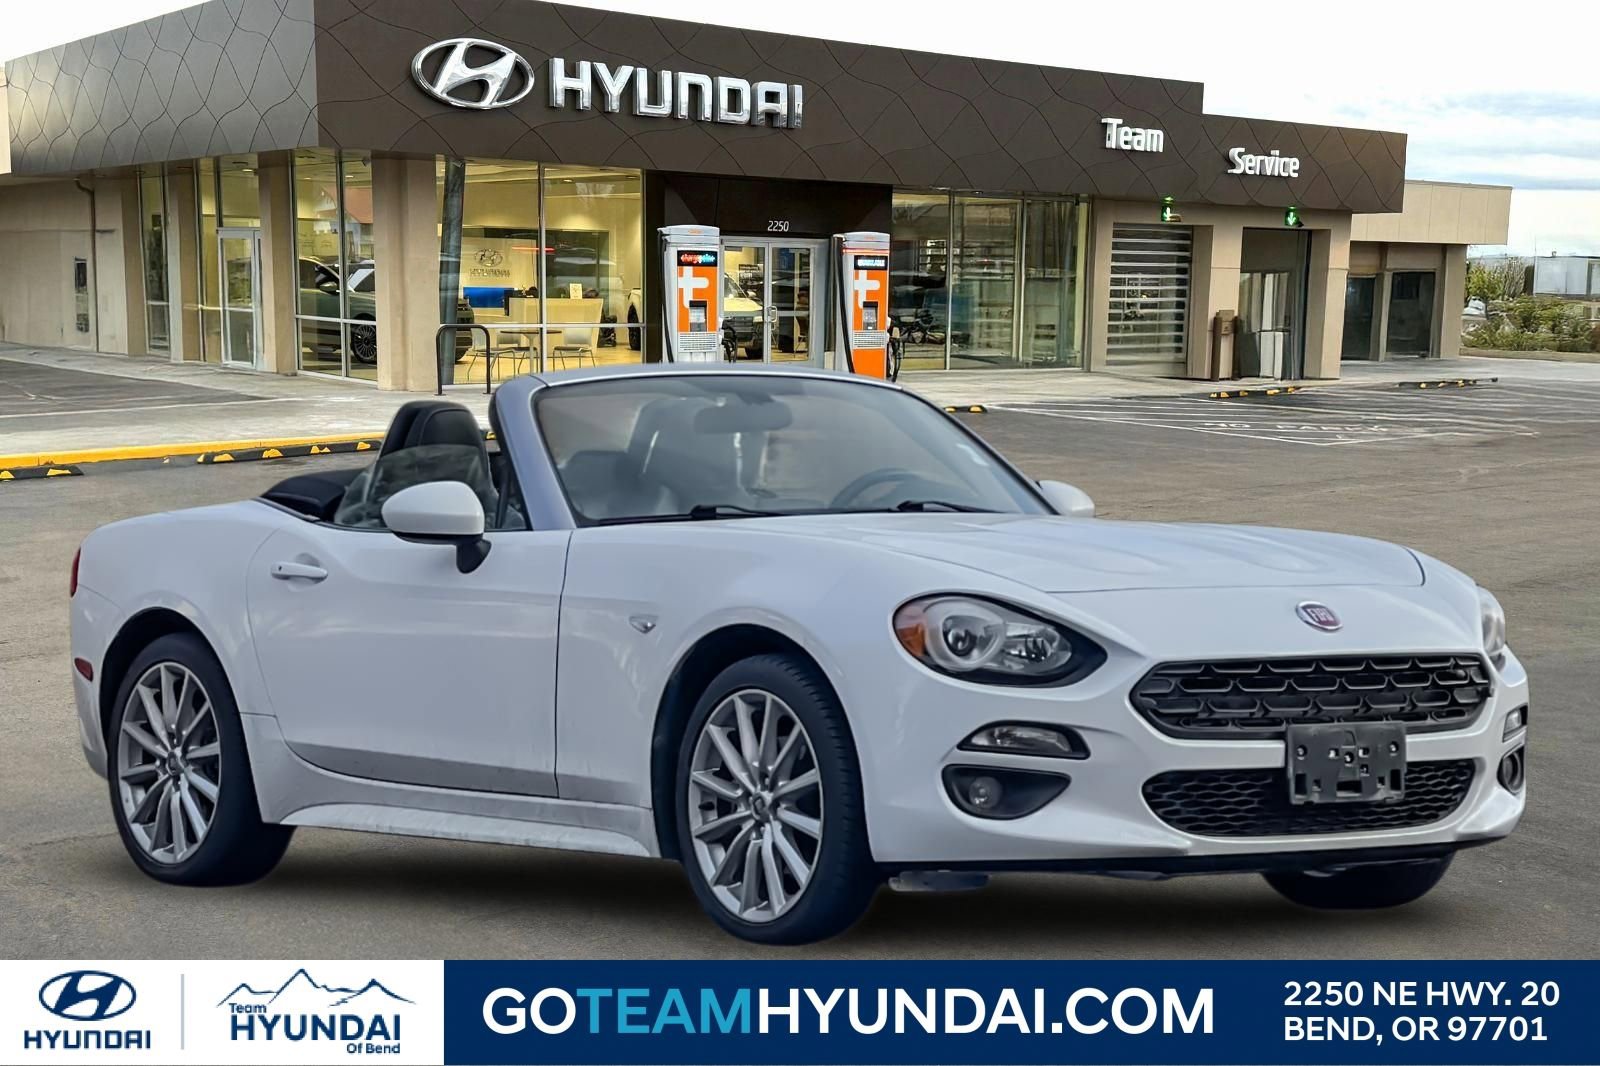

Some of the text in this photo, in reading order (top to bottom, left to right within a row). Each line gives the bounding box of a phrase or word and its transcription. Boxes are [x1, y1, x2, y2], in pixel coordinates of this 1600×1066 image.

[549, 57, 803, 129] HYUNDAI
[1101, 117, 1164, 152] Team
[1227, 147, 1300, 178] Service
[767, 220, 790, 232] 2250
